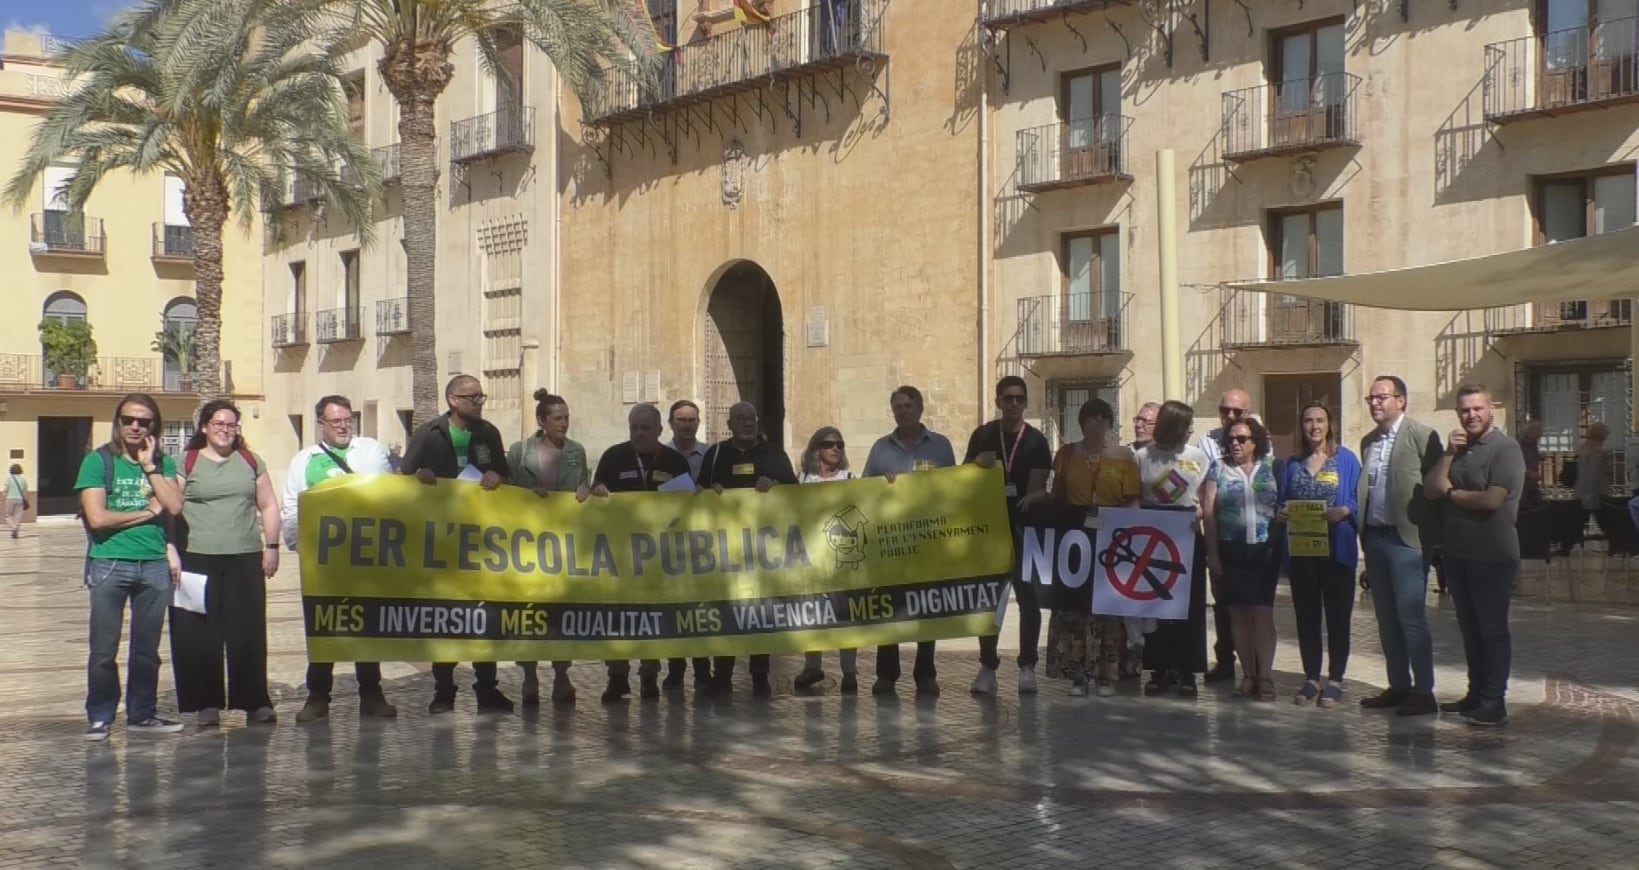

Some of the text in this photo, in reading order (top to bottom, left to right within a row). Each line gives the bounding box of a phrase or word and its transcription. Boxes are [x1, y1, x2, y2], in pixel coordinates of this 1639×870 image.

[317, 515, 813, 578] PER L'ESCOLA PÚBLICA
[876, 515, 947, 535] PLATAFORMA
[878, 524, 990, 547] PER L'ENSENYAMENT
[1022, 526, 1092, 588] NO
[313, 580, 1000, 638] MÉS INVERSIÓ MÉS QUALITAT MÉS VALENCIÀ MÉS DIGNITAT
